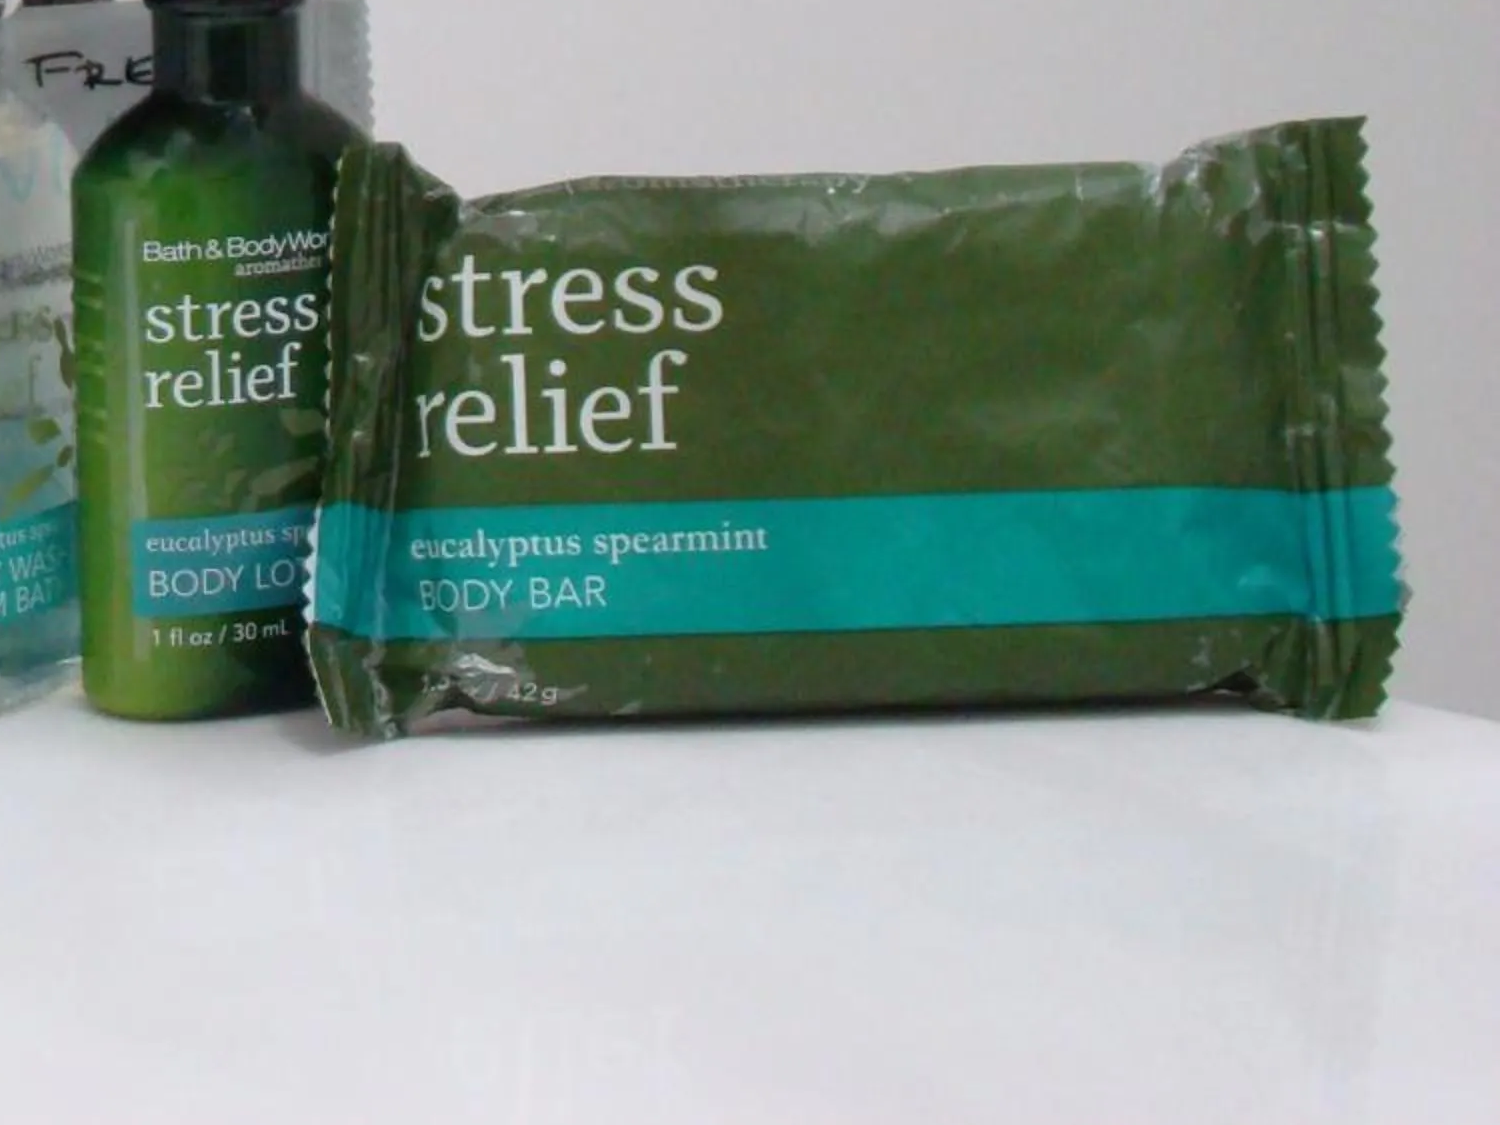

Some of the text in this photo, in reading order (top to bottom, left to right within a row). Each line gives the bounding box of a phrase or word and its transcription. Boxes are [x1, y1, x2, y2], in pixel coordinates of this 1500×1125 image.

[143, 240, 202, 262] Bath
[204, 238, 224, 261] &
[234, 253, 322, 277] aromather
[417, 253, 724, 343] stress
[145, 291, 320, 344] stress
[144, 343, 302, 408] relief
[416, 349, 689, 459] relief
[146, 528, 275, 556] eucalyptus
[410, 521, 769, 568] eucalyptus spearmint
[150, 564, 244, 597] BODY
[419, 575, 607, 612] BODY BAR
[169, 628, 183, 647] fl
[189, 632, 213, 646] oz
[233, 622, 257, 642] 30
[262, 619, 289, 638] mL
